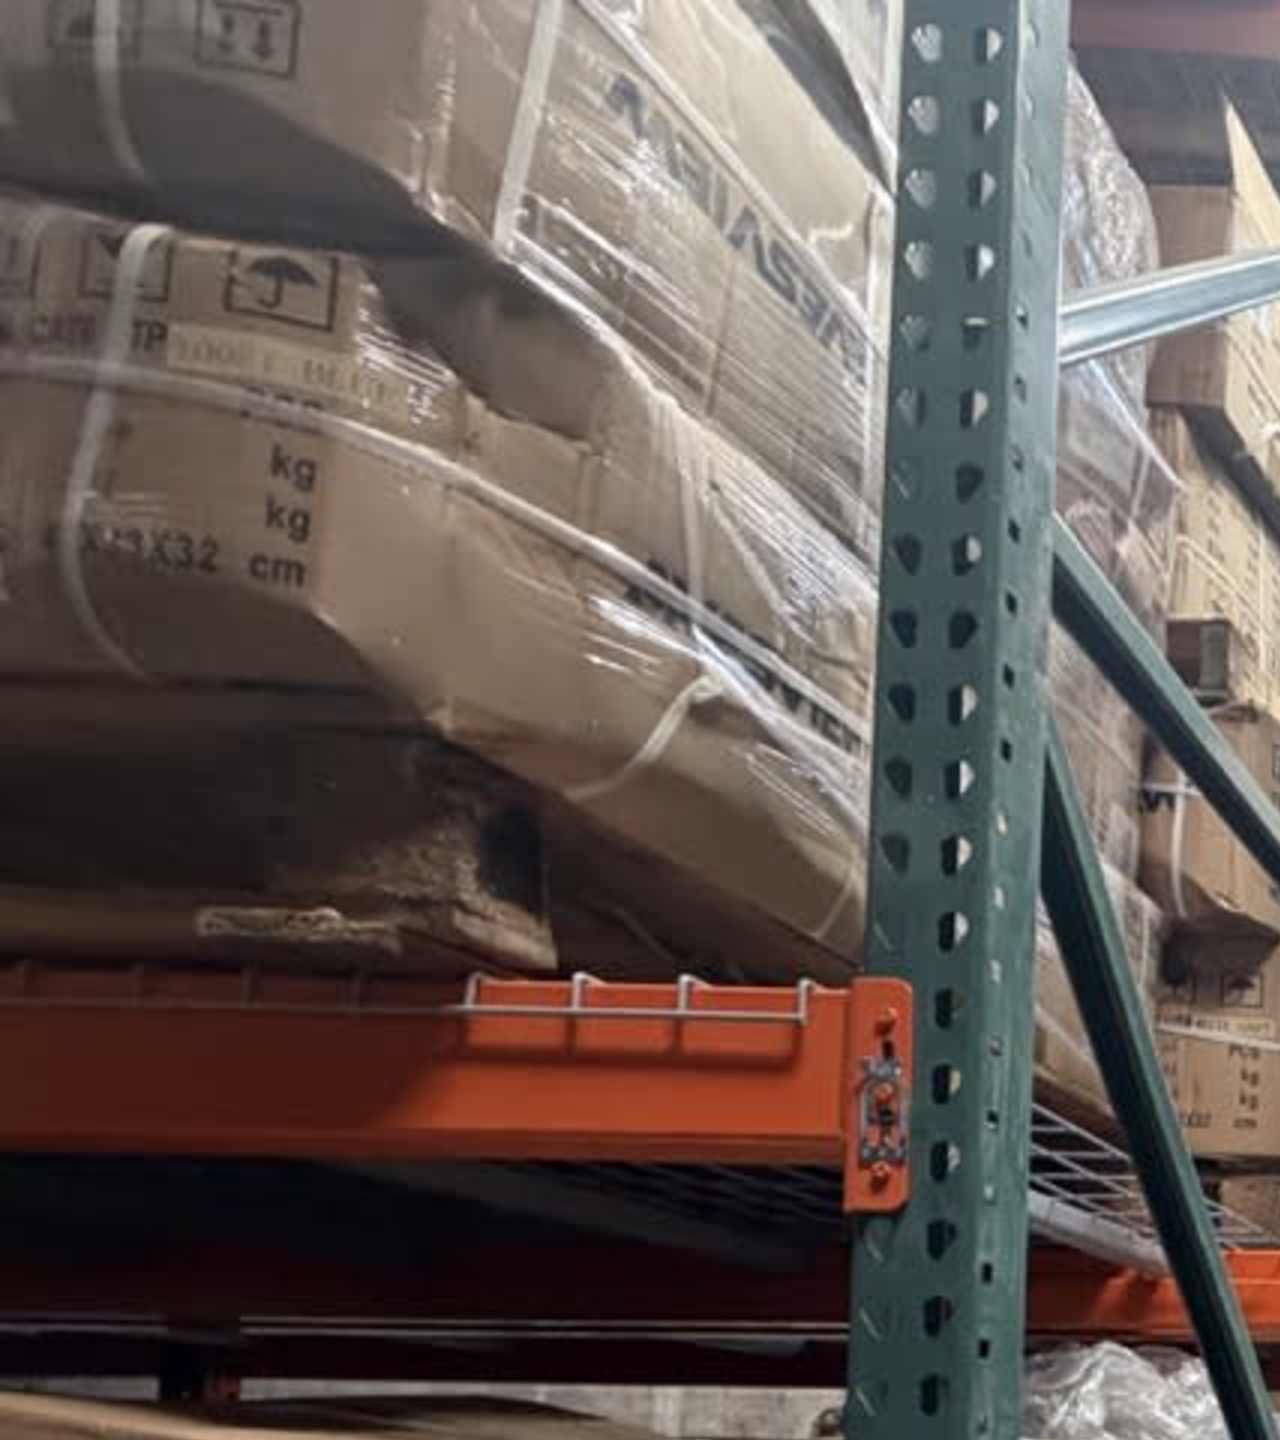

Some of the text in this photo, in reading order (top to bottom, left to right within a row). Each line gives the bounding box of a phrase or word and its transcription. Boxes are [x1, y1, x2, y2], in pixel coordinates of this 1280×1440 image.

[270, 444, 319, 492] kg
[265, 496, 313, 543] kg
[248, 548, 307, 586] cm
